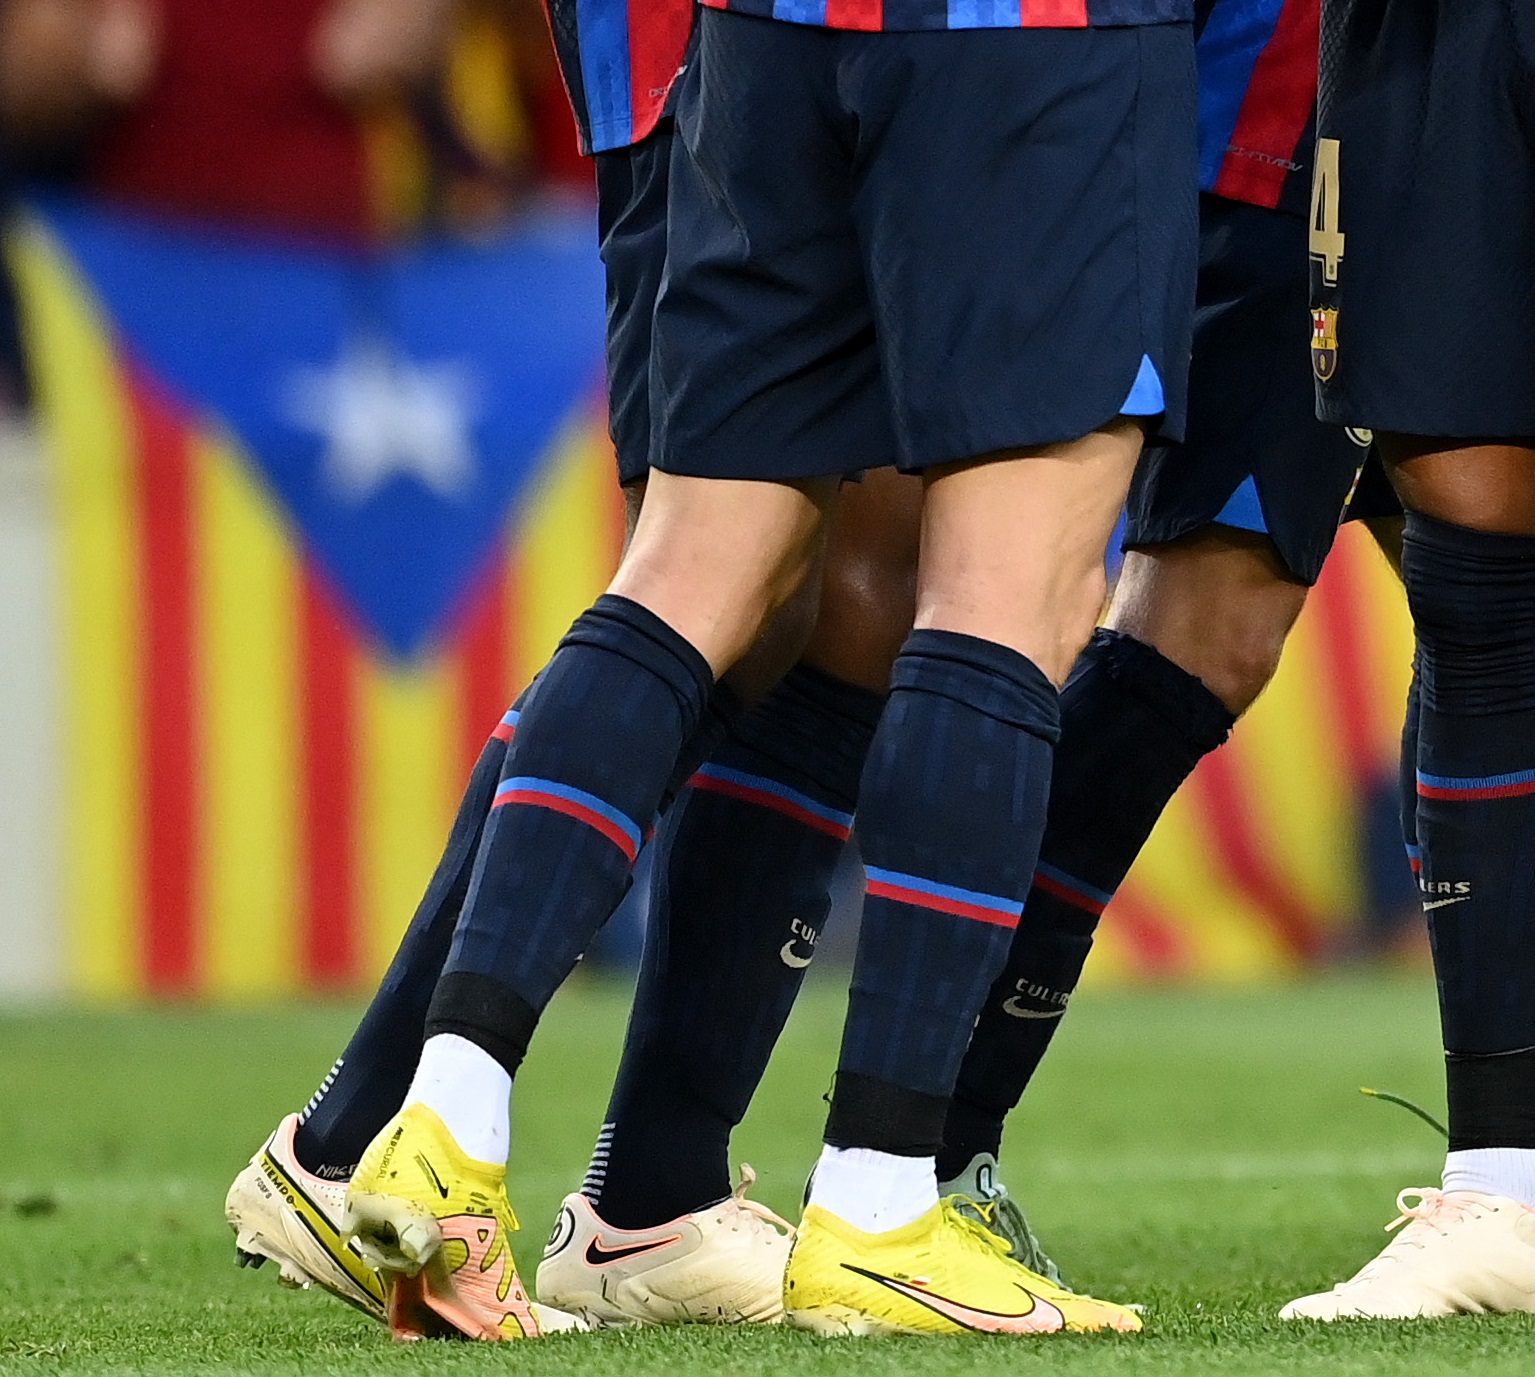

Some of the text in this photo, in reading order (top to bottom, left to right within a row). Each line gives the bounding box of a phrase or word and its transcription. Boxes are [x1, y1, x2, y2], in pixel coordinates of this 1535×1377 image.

[1309, 137, 1345, 287] 4
[1420, 877, 1471, 894] LERS
[1015, 978, 1070, 1007] CULER
